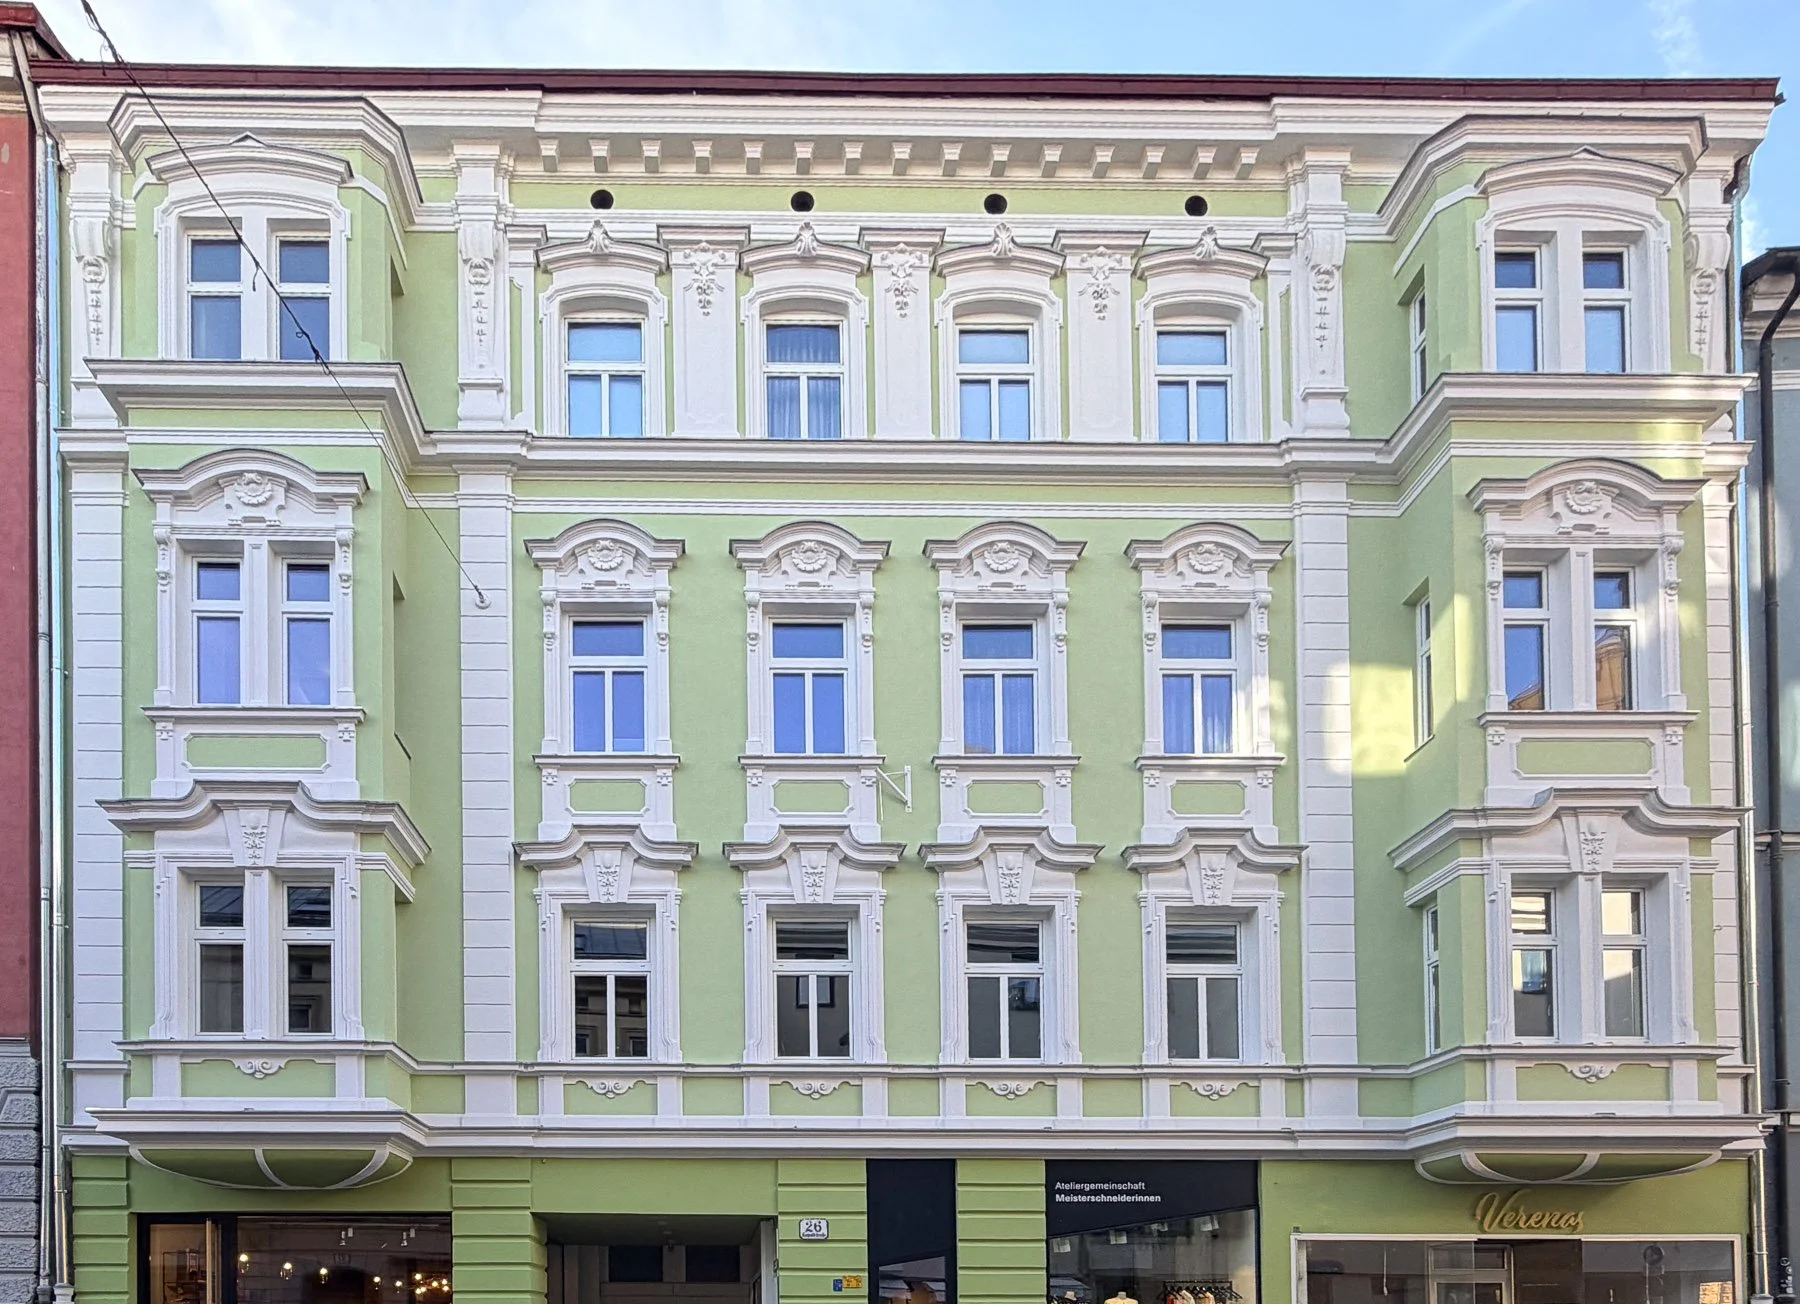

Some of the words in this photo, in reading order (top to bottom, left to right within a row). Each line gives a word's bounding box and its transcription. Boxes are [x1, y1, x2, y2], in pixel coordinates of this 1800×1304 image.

[1055, 1181, 1146, 1192] Ateliergemeinschaft
[1055, 1193, 1162, 1203] Meisterschneiderinnen
[1474, 1188, 1585, 1233] Verenas
[805, 1220, 822, 1233] 26
